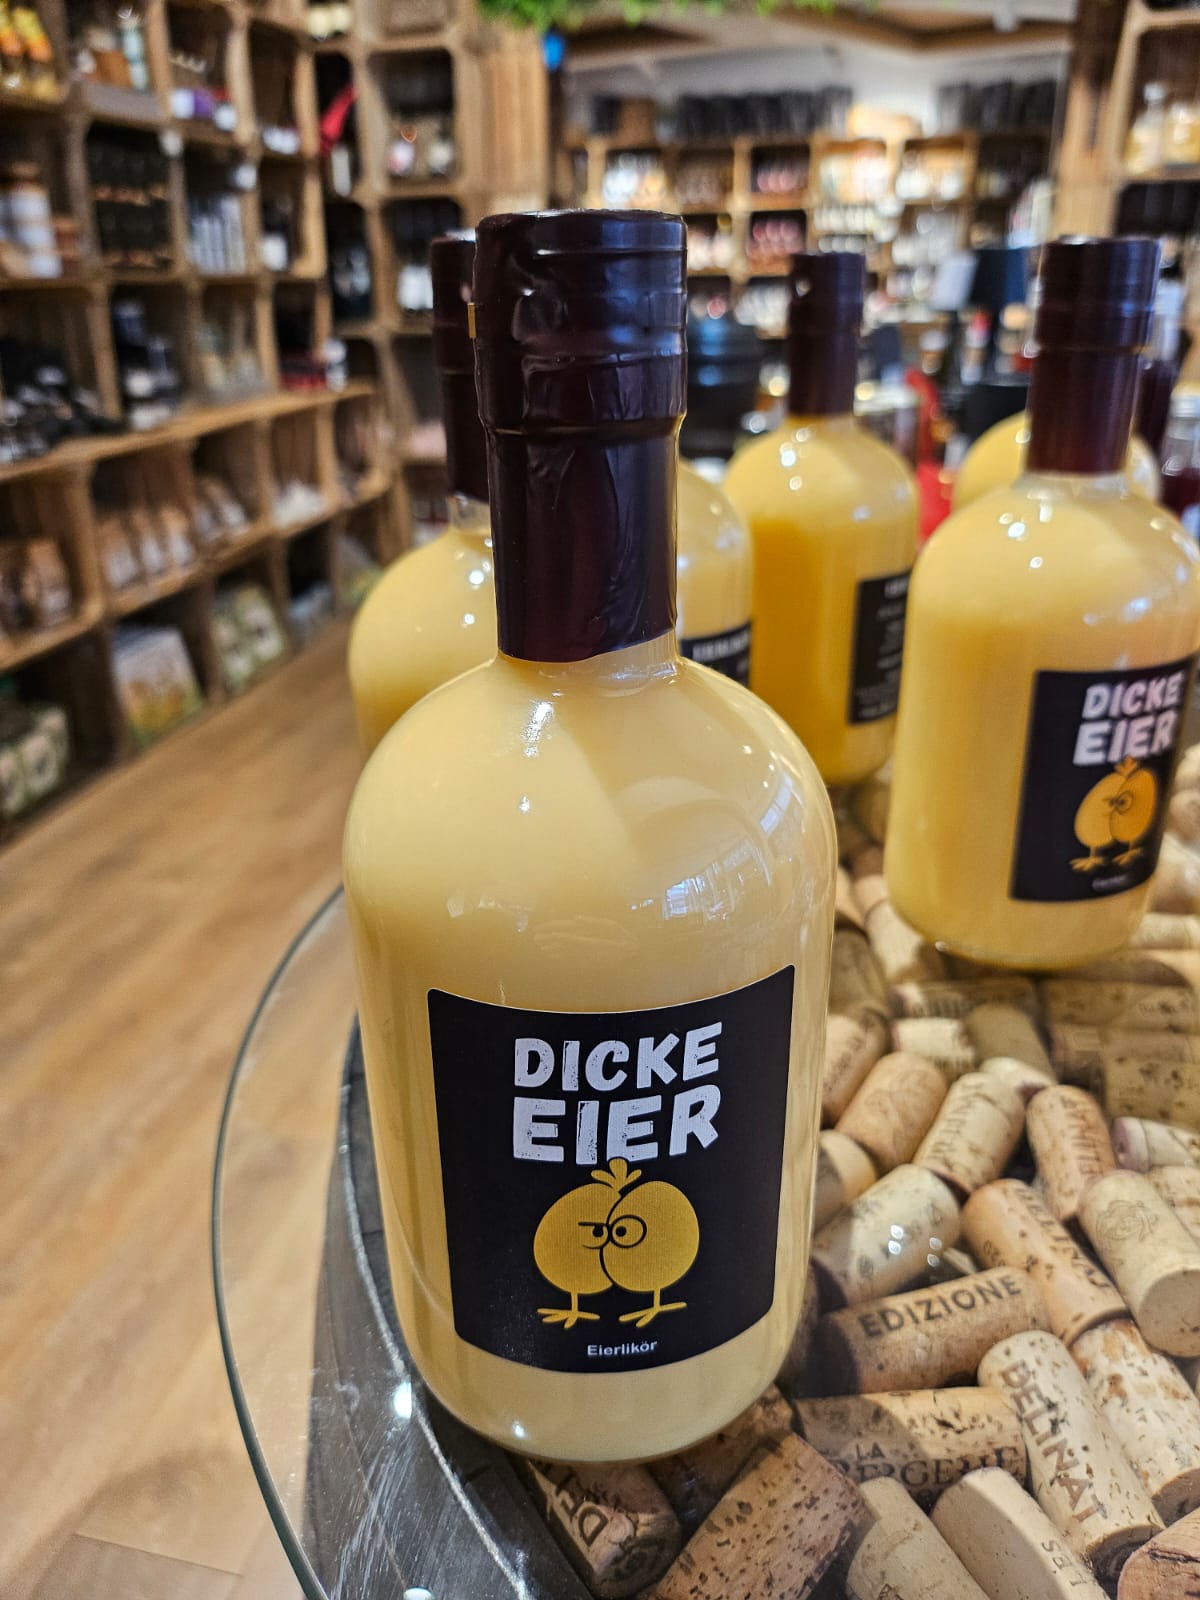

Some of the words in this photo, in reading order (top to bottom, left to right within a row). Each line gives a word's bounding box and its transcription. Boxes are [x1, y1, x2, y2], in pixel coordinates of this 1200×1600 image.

[1081, 670, 1184, 719] DICKE
[1072, 711, 1178, 766] EIER
[514, 1021, 722, 1091] DICKE
[513, 1084, 721, 1165] EIER
[858, 1275, 1023, 1338] EDIZIONE
[586, 1340, 658, 1357] Eierlikör
[855, 1441, 886, 1459] LA
